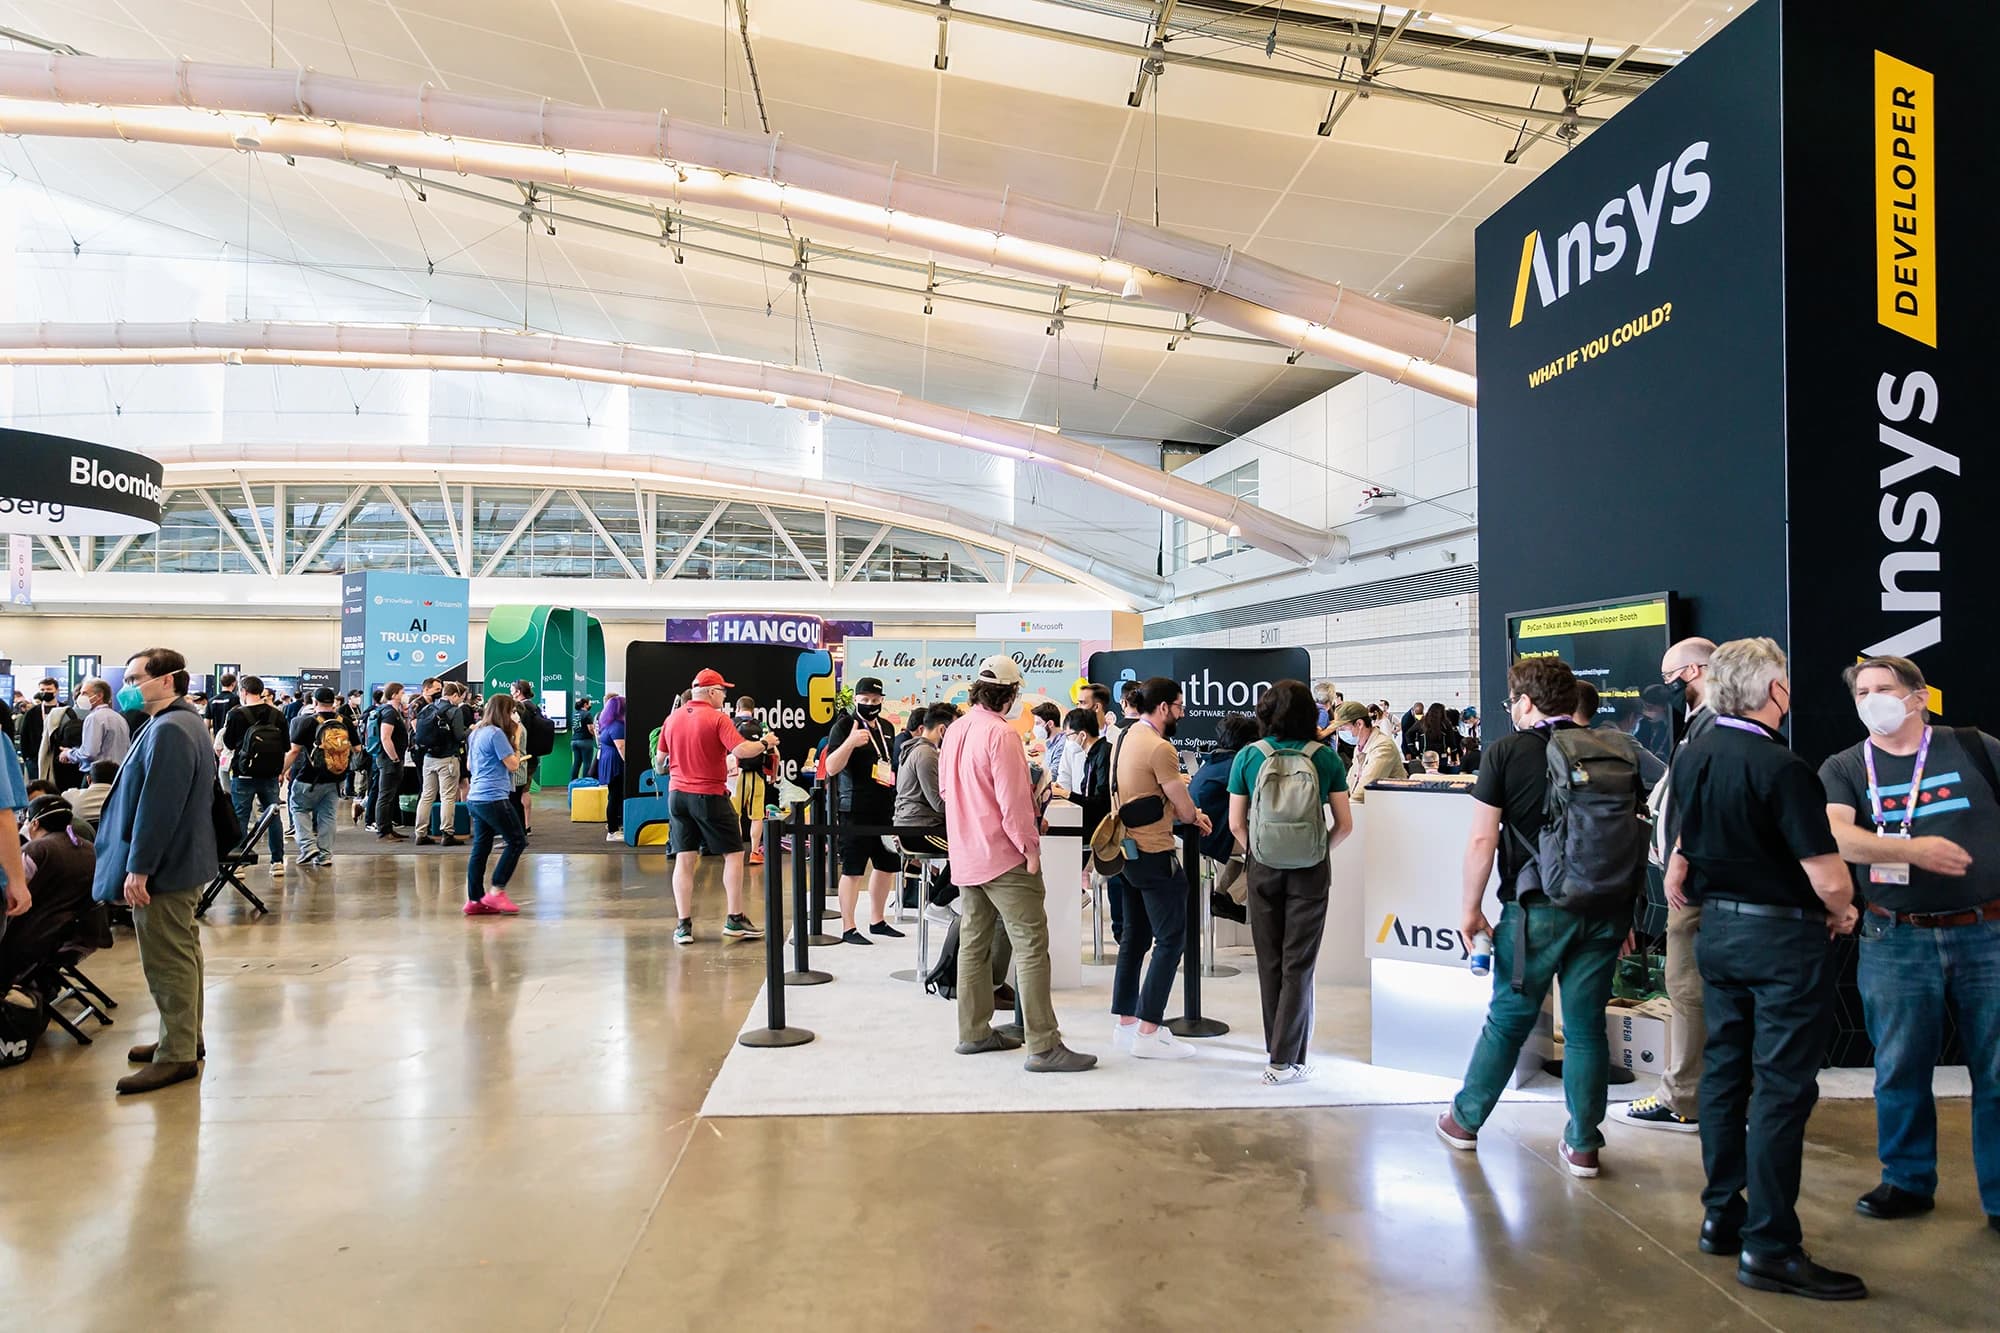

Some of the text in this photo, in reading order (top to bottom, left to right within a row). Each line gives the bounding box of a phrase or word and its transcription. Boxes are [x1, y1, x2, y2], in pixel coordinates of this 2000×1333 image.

[1892, 86, 1919, 317] DEVELOPER
[1510, 141, 1712, 329] Ansys
[1528, 302, 1673, 389] WHAT IF YOU COULD?
[1857, 370, 1961, 716] Ansys
[409, 618, 427, 632] AI
[1032, 621, 1064, 631] Microsoft
[1590, 615, 1618, 625] Developer
[1620, 612, 1638, 621] Booth
[380, 631, 456, 645] TRULY OPEN
[1261, 627, 1279, 644] EXIT
[873, 650, 888, 668] In
[893, 652, 916, 667] the
[932, 653, 977, 668] world
[1011, 651, 1064, 673] Python
[1189, 709, 1225, 718] SOFTWARE
